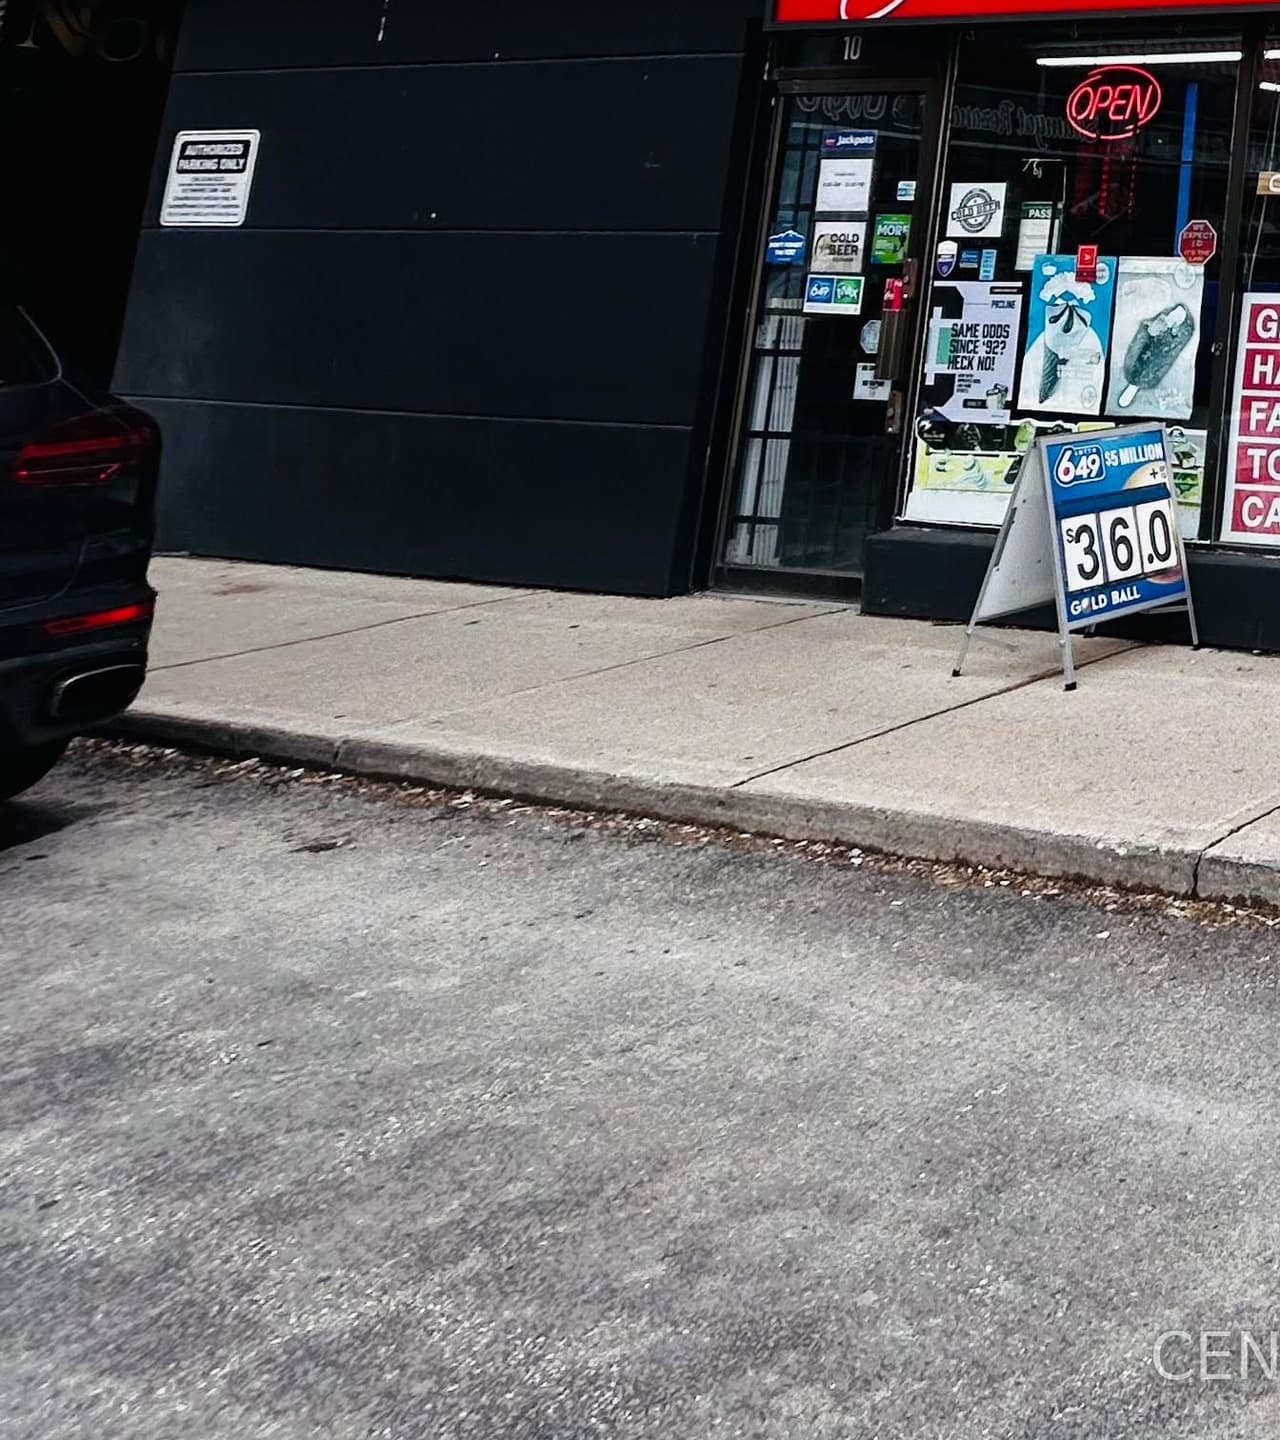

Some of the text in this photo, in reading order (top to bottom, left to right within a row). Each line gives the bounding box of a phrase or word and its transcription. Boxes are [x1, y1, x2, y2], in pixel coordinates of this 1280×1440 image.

[843, 36, 862, 60] 10
[1074, 82, 1155, 123] OPEN
[836, 135, 874, 147] Jackpots
[830, 233, 860, 244] COLD
[1183, 232, 1213, 240] EXPECT
[829, 244, 859, 257] BEER
[951, 323, 1011, 339] SAME ODDS
[949, 340, 979, 355] SINCE
[947, 355, 996, 372] HECK NO!
[1104, 449, 1119, 468] $5
[1118, 442, 1164, 466] MILLION
[1111, 585, 1142, 606] BALL
